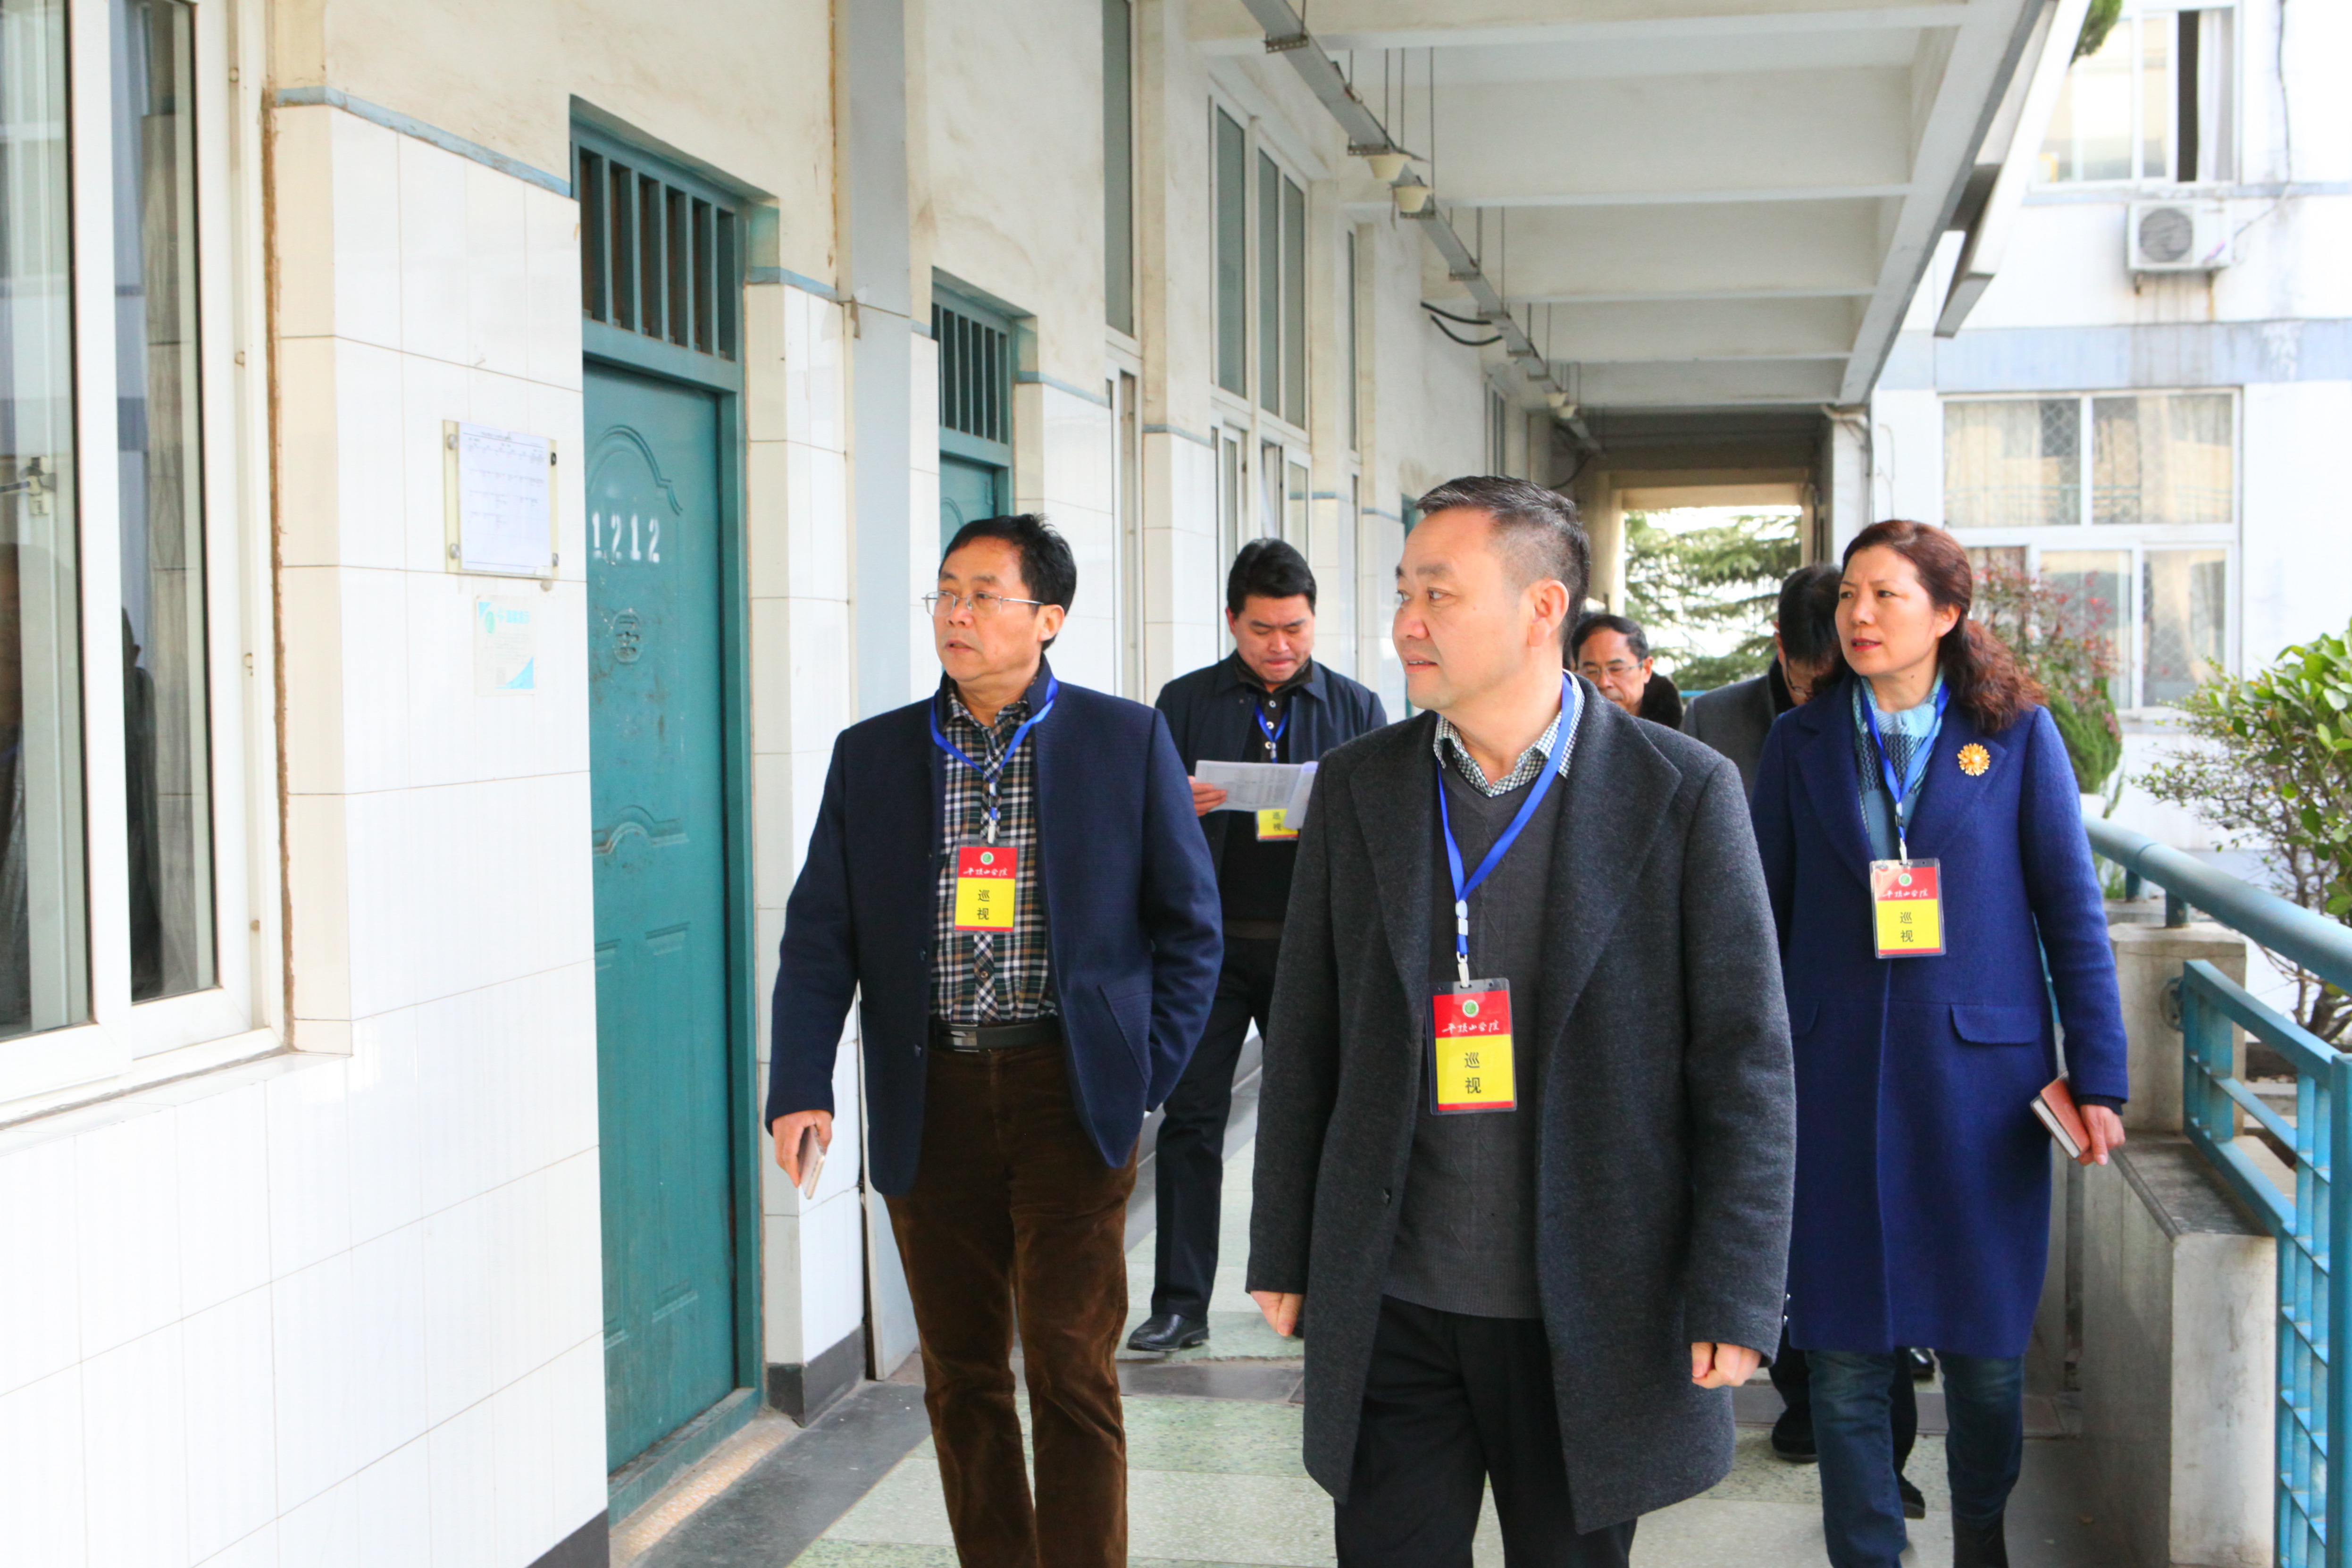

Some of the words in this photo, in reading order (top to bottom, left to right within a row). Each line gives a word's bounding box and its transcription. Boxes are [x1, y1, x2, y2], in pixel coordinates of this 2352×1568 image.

[592, 512, 660, 563] 1212
[977, 889, 990, 920] 巡视
[1900, 912, 1914, 943] 巡视
[1464, 1052, 1482, 1094] 巡视
